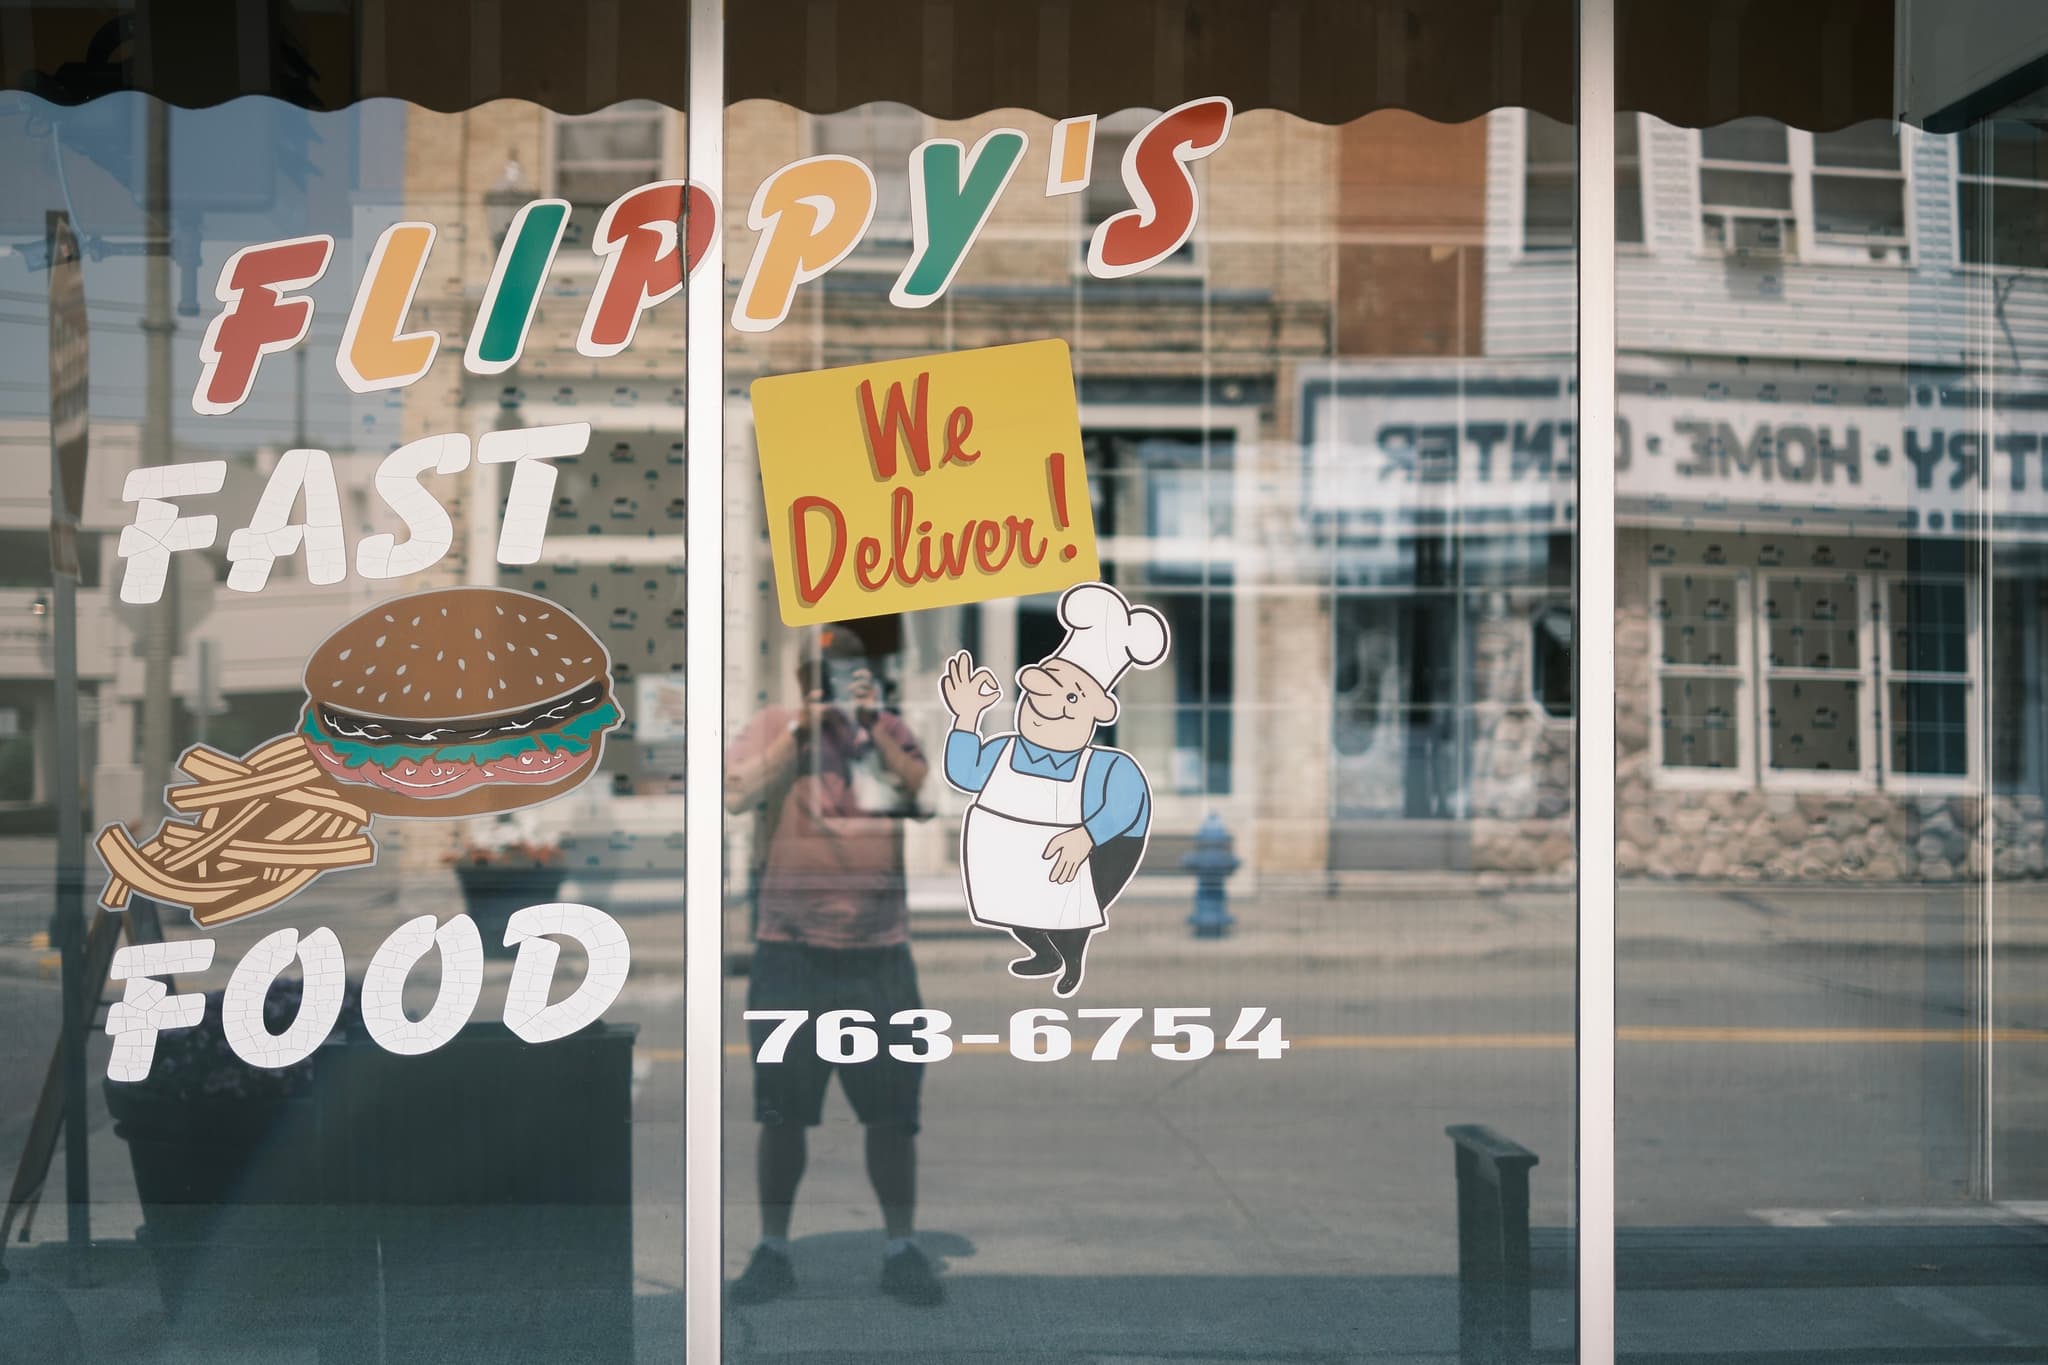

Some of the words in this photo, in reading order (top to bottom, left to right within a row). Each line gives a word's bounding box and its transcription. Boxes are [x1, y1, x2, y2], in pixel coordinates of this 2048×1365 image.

[193, 97, 1233, 416] FLIPPY'S
[857, 372, 981, 482] We
[118, 421, 591, 604] FAST
[788, 452, 1078, 609] Deliver!
[105, 902, 631, 1083] FOOD
[742, 1006, 1291, 1064] 763-6754
